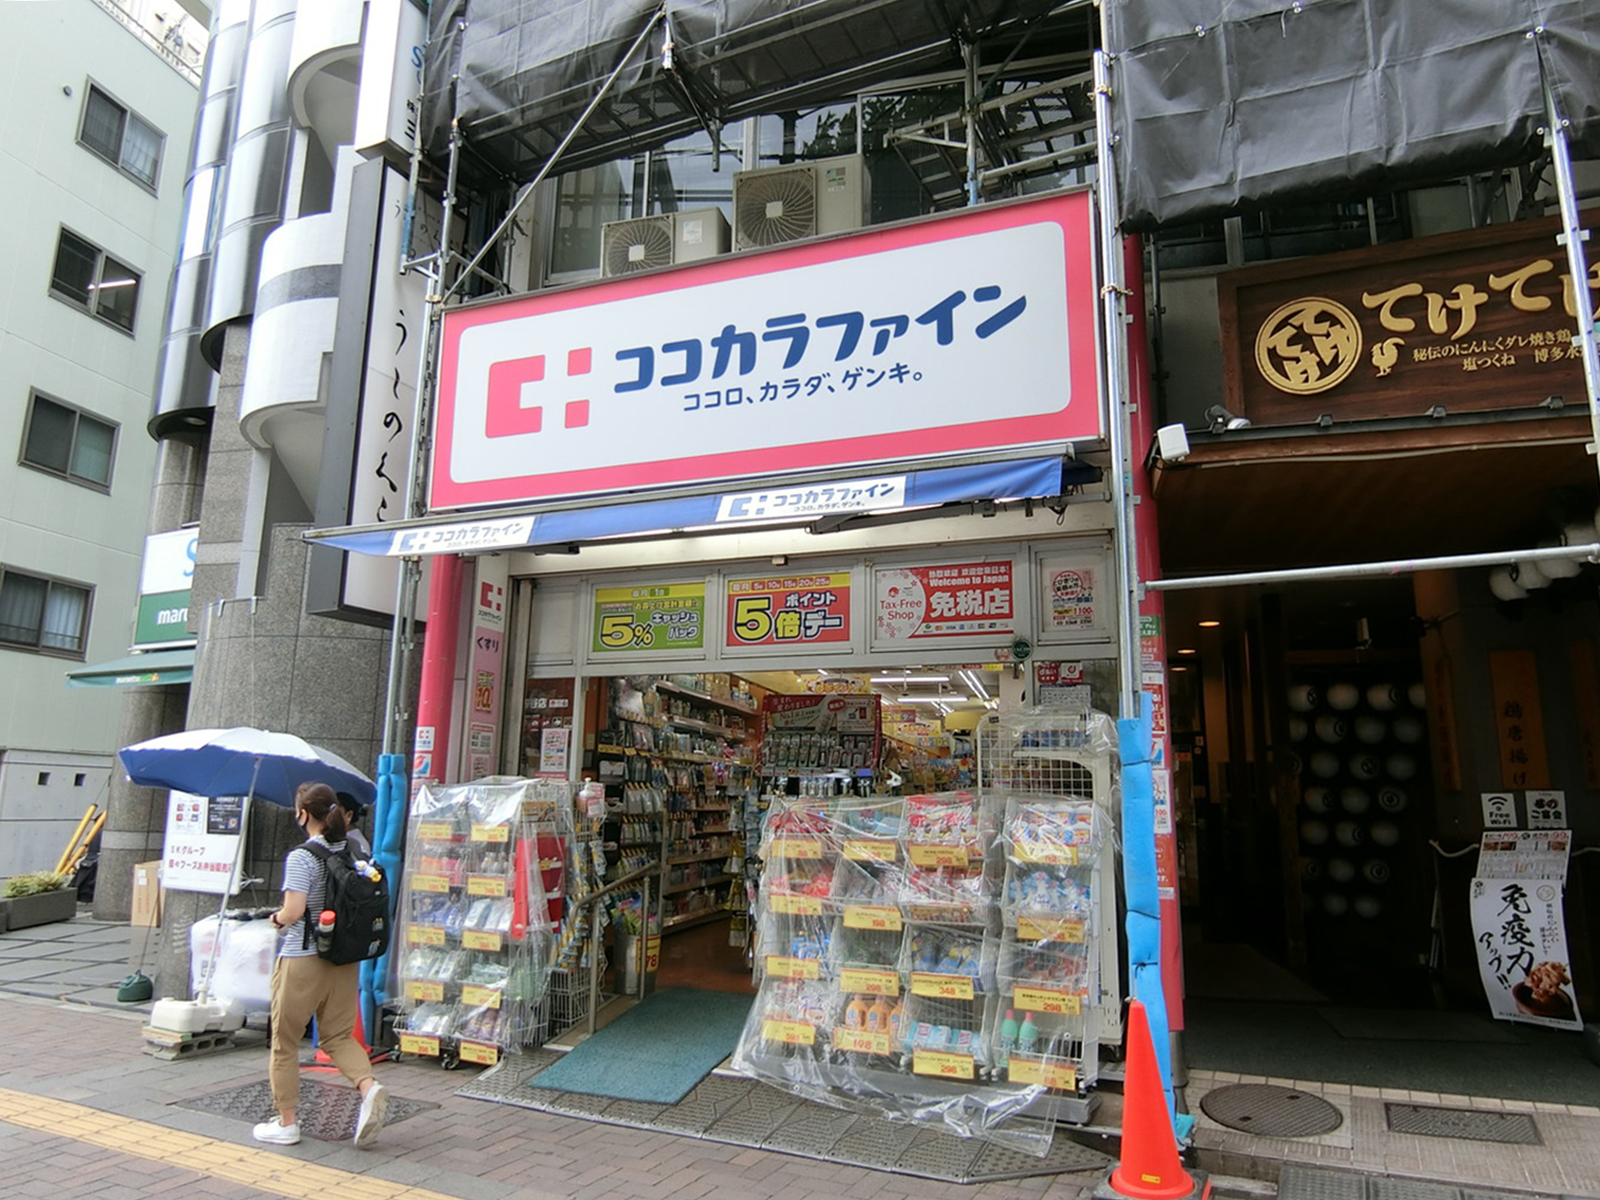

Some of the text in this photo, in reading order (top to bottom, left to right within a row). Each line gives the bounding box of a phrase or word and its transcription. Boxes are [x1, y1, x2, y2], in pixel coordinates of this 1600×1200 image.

[614, 285, 1027, 393] ココカラファイン
[1462, 346, 1587, 372] 塩つくね 博多水
[683, 362, 923, 412] ココロ、カラダ、ゲンキ。
[772, 483, 895, 507] ココカラファイン
[432, 522, 524, 543] ココカラファイン
[929, 574, 1009, 588] Welcome to Japan
[785, 591, 837, 609] ポイント
[880, 599, 922, 611] Tax-Free
[929, 588, 1011, 618] 免税店
[651, 610, 700, 626] キャッシュ
[887, 610, 915, 622] Shop
[477, 636, 499, 653] くすり
[1489, 811, 1511, 819] Free
[1490, 818, 1512, 826] Wi-Fi
[1497, 884, 1536, 978] 免疫力
